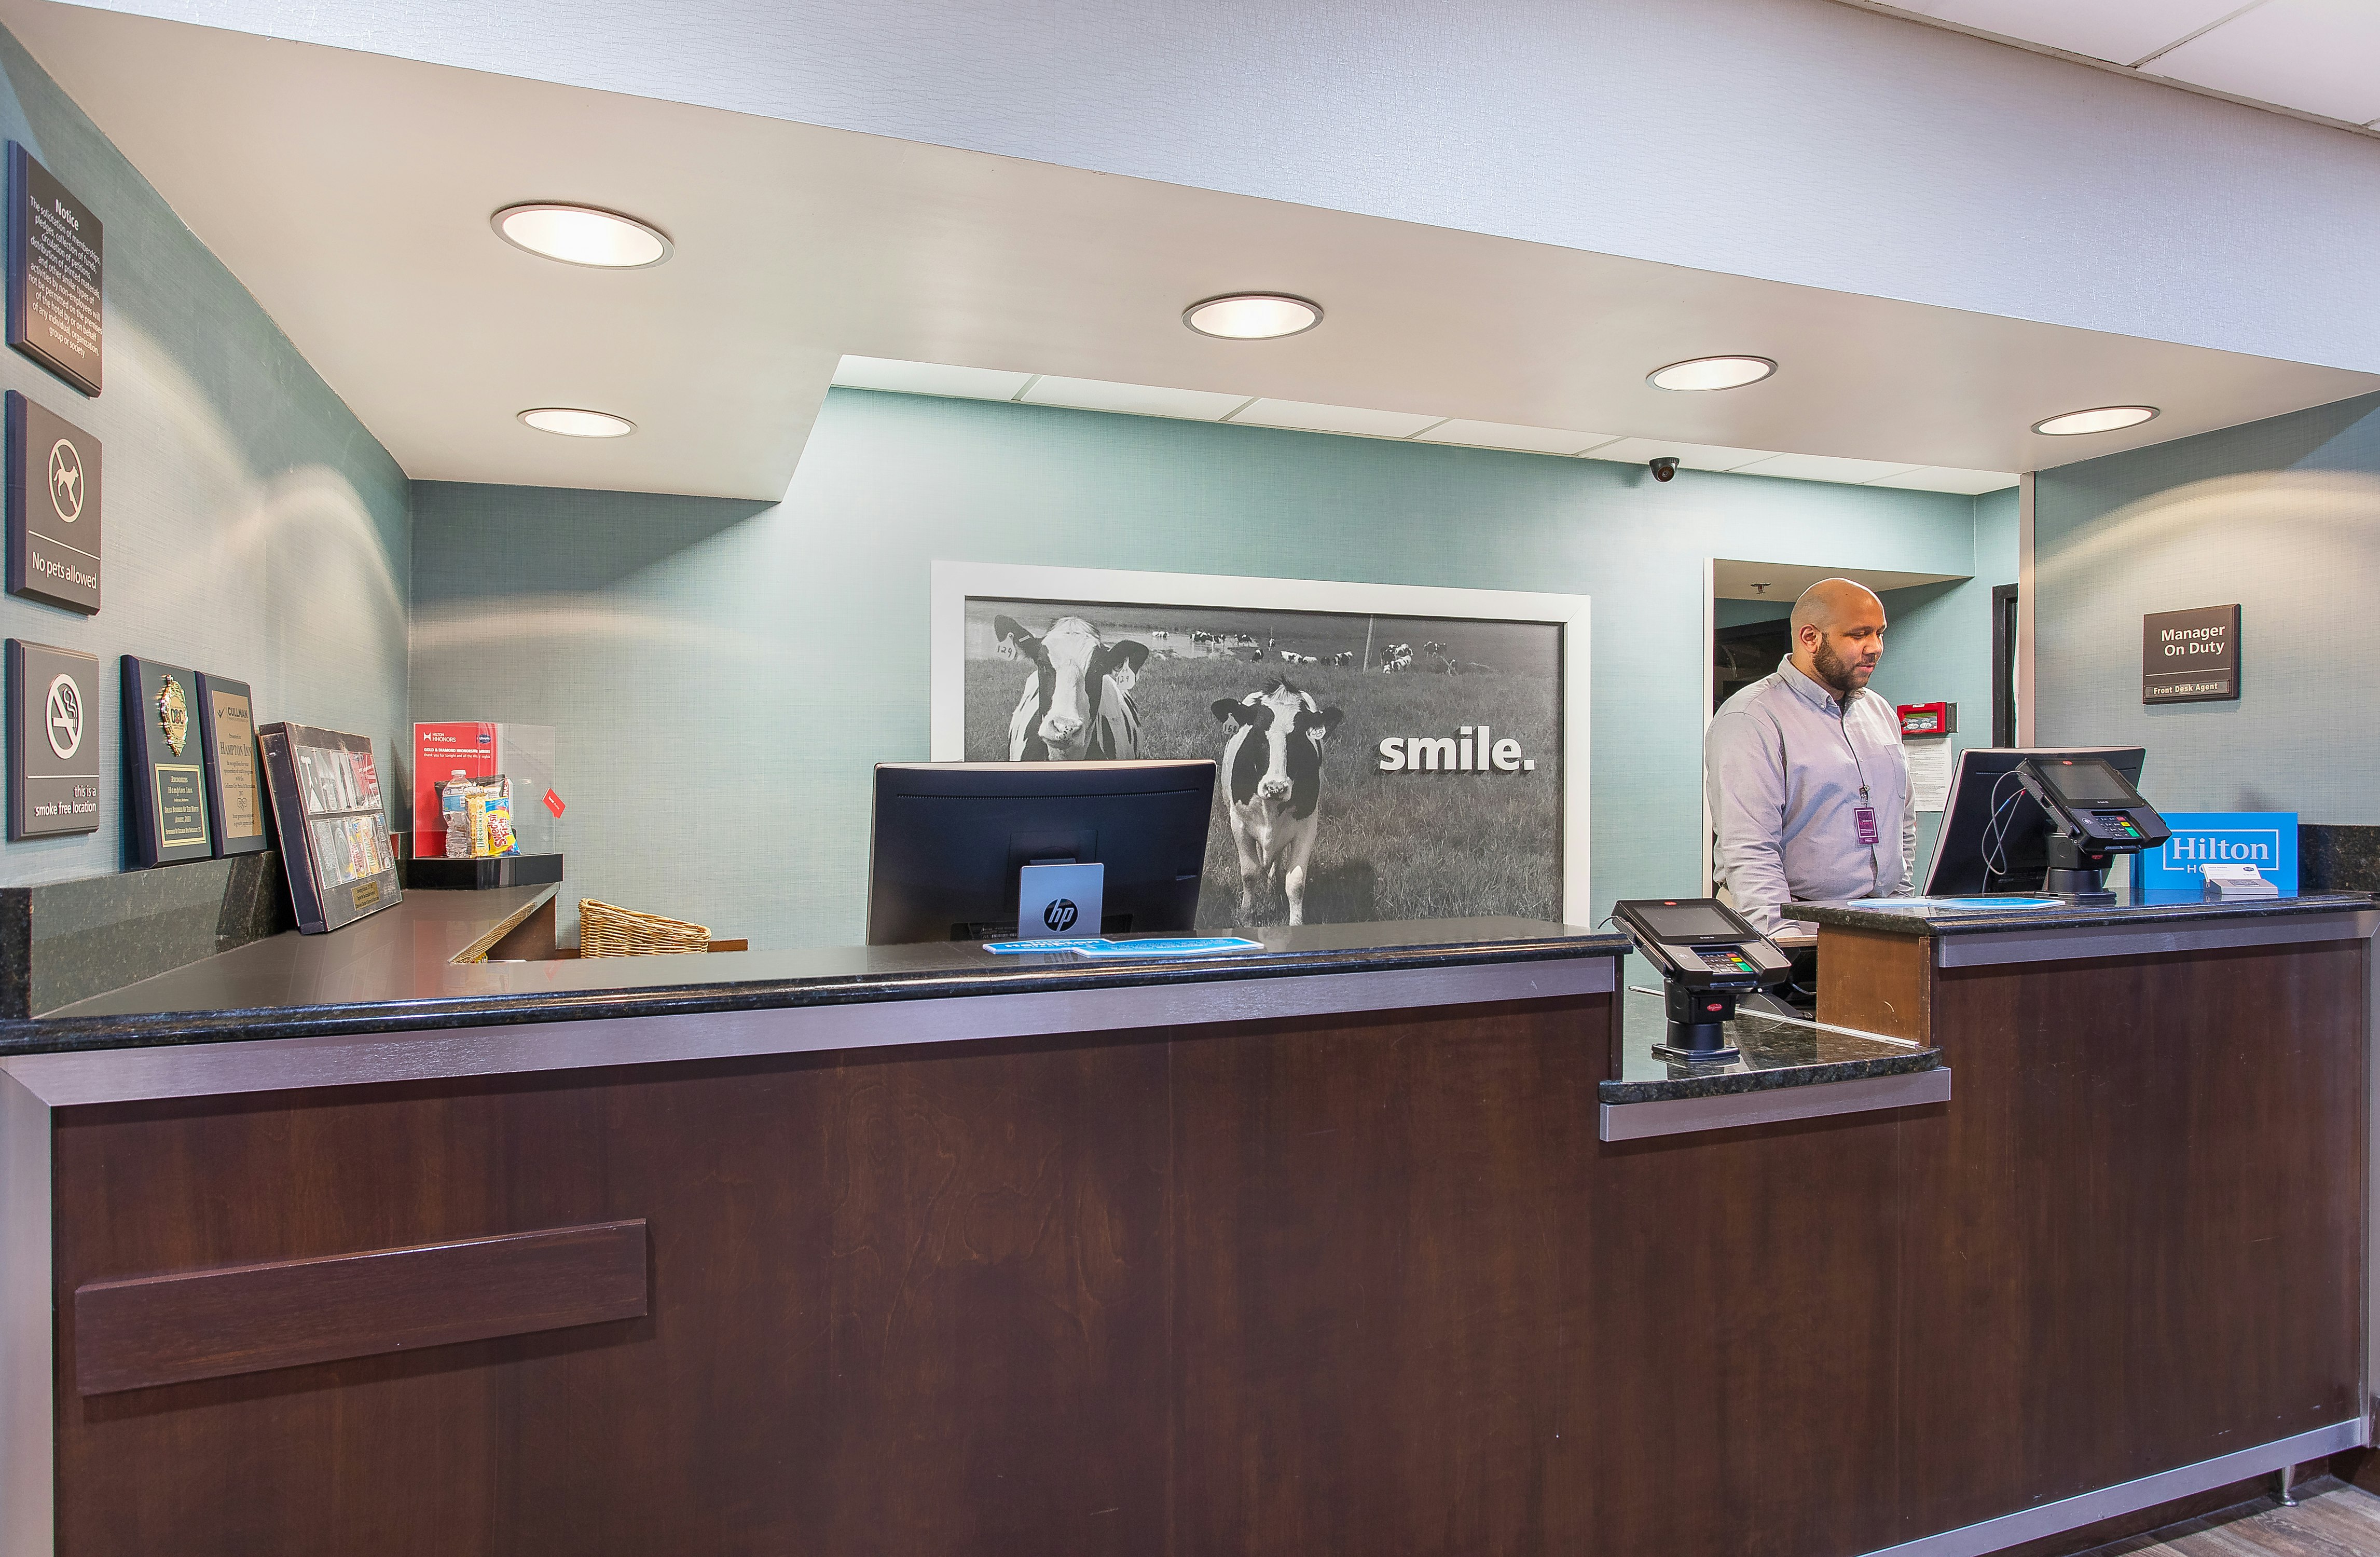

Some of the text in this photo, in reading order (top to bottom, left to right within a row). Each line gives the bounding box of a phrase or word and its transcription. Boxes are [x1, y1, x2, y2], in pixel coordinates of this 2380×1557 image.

[30, 196, 101, 266] The solicitation of memberships,
[56, 199, 79, 231] Notice
[35, 215, 97, 274] pledges, collection of funds,
[42, 233, 91, 281] circulation of petitions,
[31, 236, 101, 301] distribution of printed materials,
[38, 256, 94, 305] and other similar types of
[29, 274, 37, 286] not
[38, 278, 45, 291] be
[46, 287, 68, 309] permitted
[70, 306, 75, 315] on
[85, 317, 102, 335] premises
[31, 263, 52, 284] activities
[52, 277, 58, 291] by
[59, 285, 92, 316] non-employees
[32, 303, 99, 357] of any individual, organization,
[36, 292, 97, 342] of the hotel by or on behalf
[49, 327, 85, 359] group or society
[32, 551, 97, 589] No pets allowed
[2162, 625, 2225, 641] Manager
[2164, 641, 2225, 656] On Duty
[2154, 686, 2172, 694] Front
[2195, 682, 2218, 692] Agent
[228, 707, 248, 718] CULLMAN
[220, 742, 243, 756] HAMPTON
[1380, 726, 1535, 770] smile.
[74, 785, 96, 797] this is a
[168, 787, 186, 796] Hampton
[35, 800, 96, 816] smoke free location
[488, 814, 507, 847] Swedish
[499, 818, 510, 838] Fish
[2172, 838, 2269, 859] Hilton
[1048, 898, 1074, 932] hp
